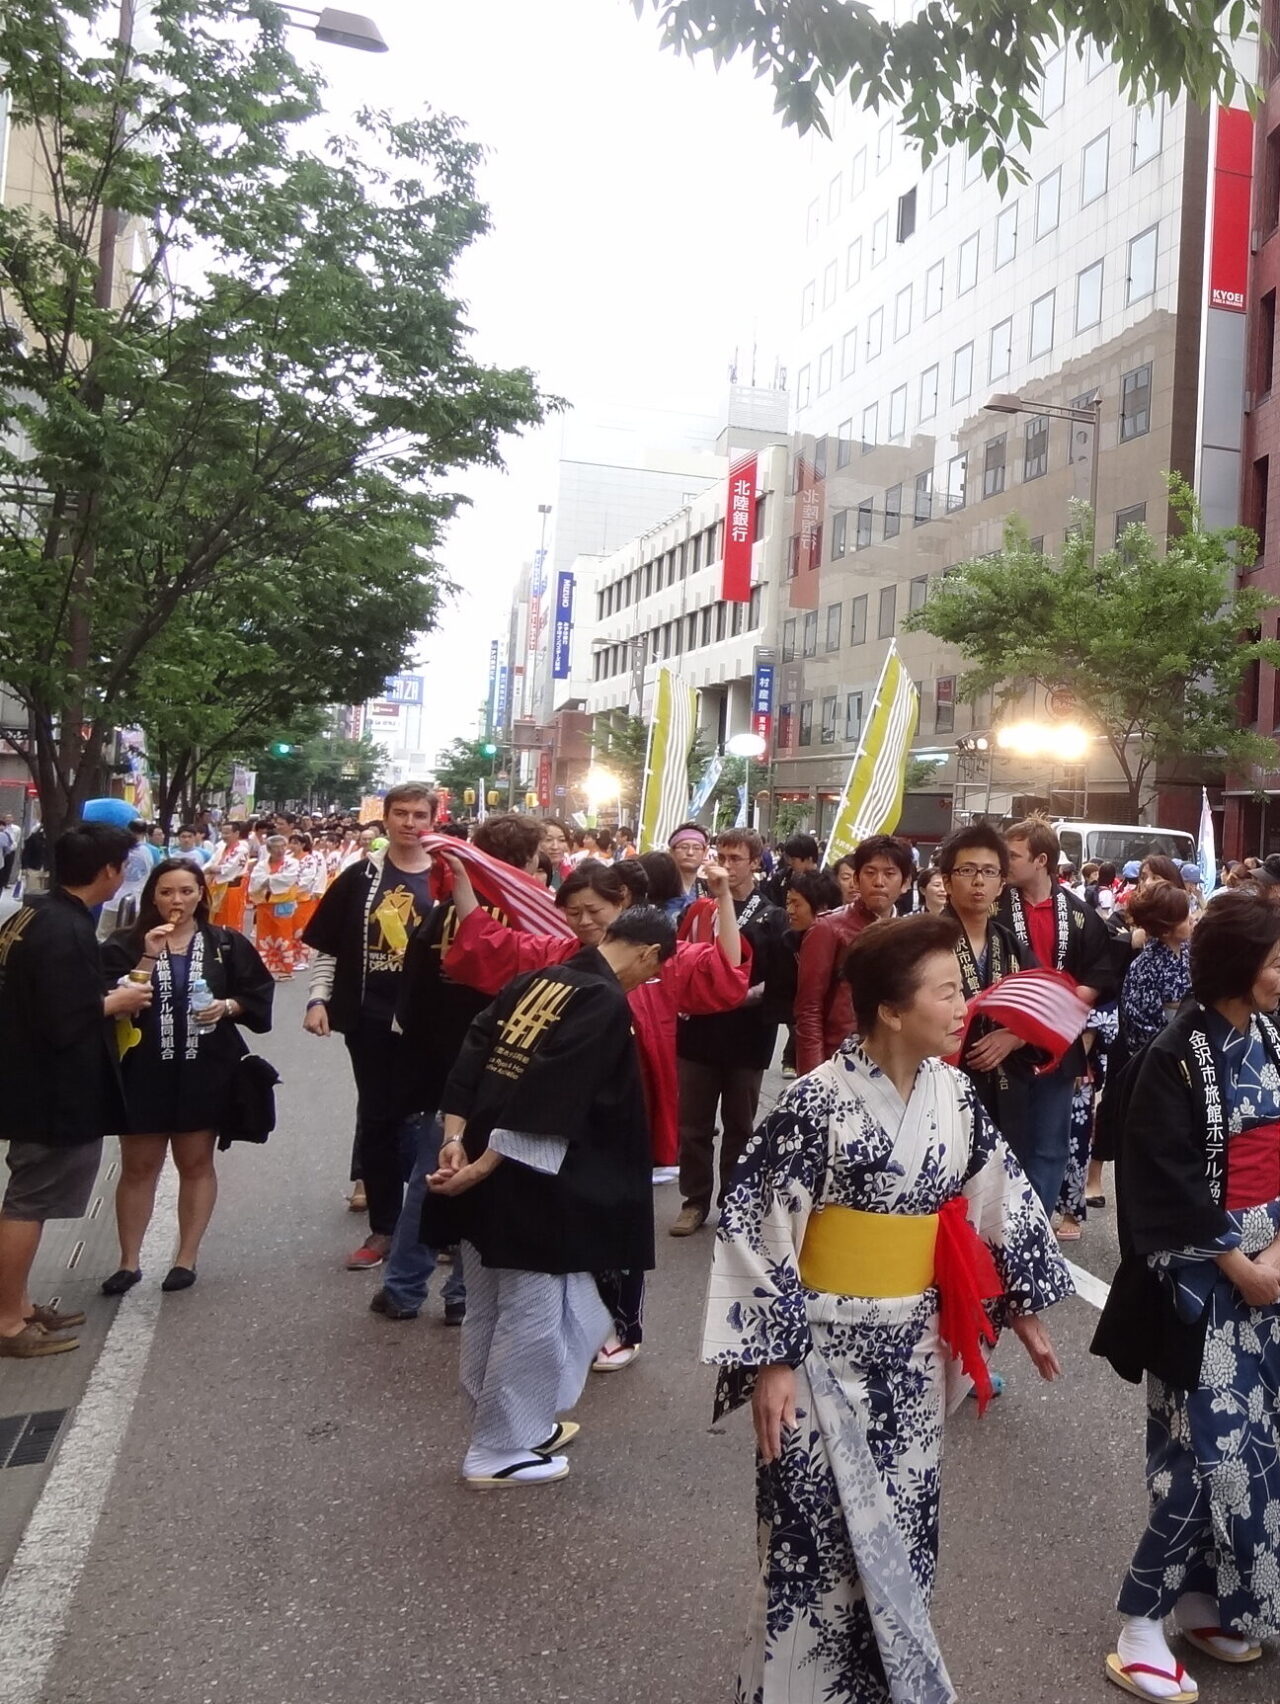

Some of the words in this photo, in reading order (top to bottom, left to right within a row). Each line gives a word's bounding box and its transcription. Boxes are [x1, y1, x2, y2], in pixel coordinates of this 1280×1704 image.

[1213, 289, 1244, 302] KYOEI
[731, 480, 751, 542] 北陸銀行
